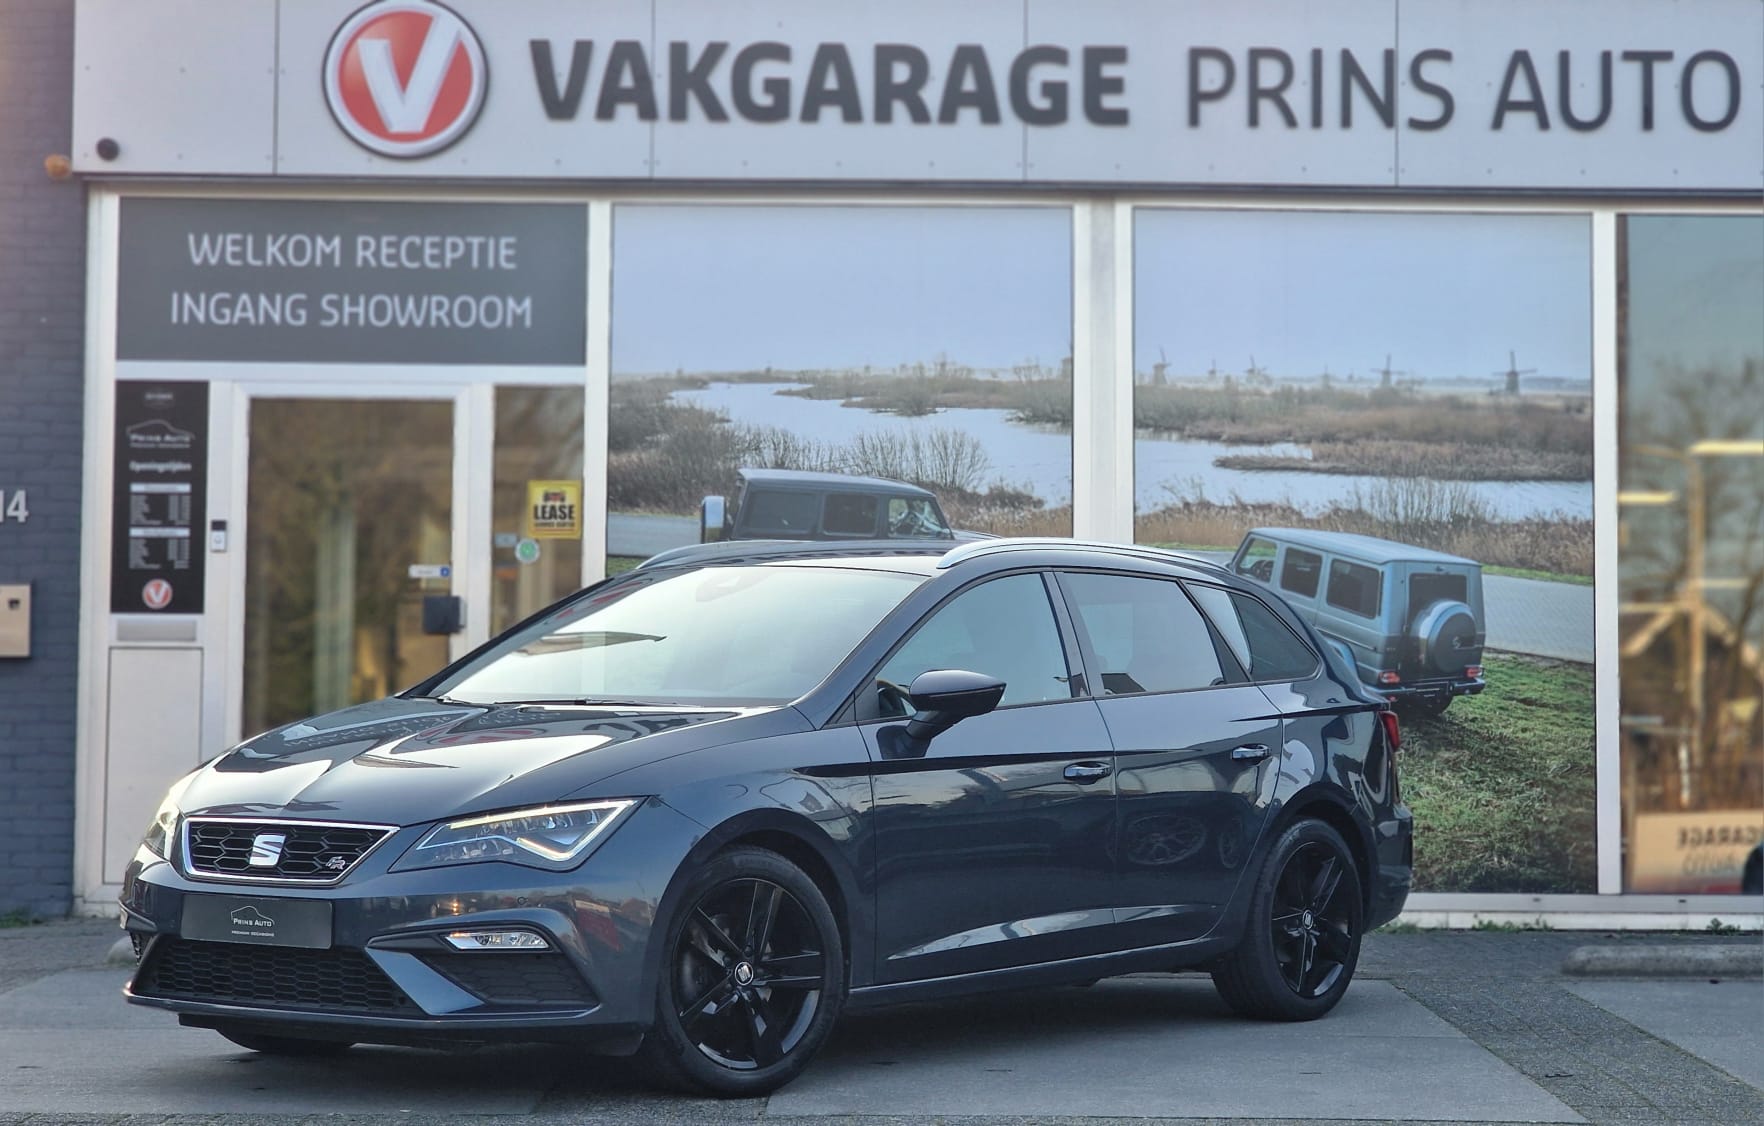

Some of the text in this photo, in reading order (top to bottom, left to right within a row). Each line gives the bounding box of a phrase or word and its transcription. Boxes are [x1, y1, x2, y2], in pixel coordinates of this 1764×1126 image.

[529, 39, 1742, 133] VAKGARAGE PRINS AUTO
[187, 233, 517, 269] WELKOM RECEPTIE
[170, 292, 533, 329] INGANG SHOWROOM
[533, 504, 576, 521] LEASE
[254, 919, 273, 927] AUTO
